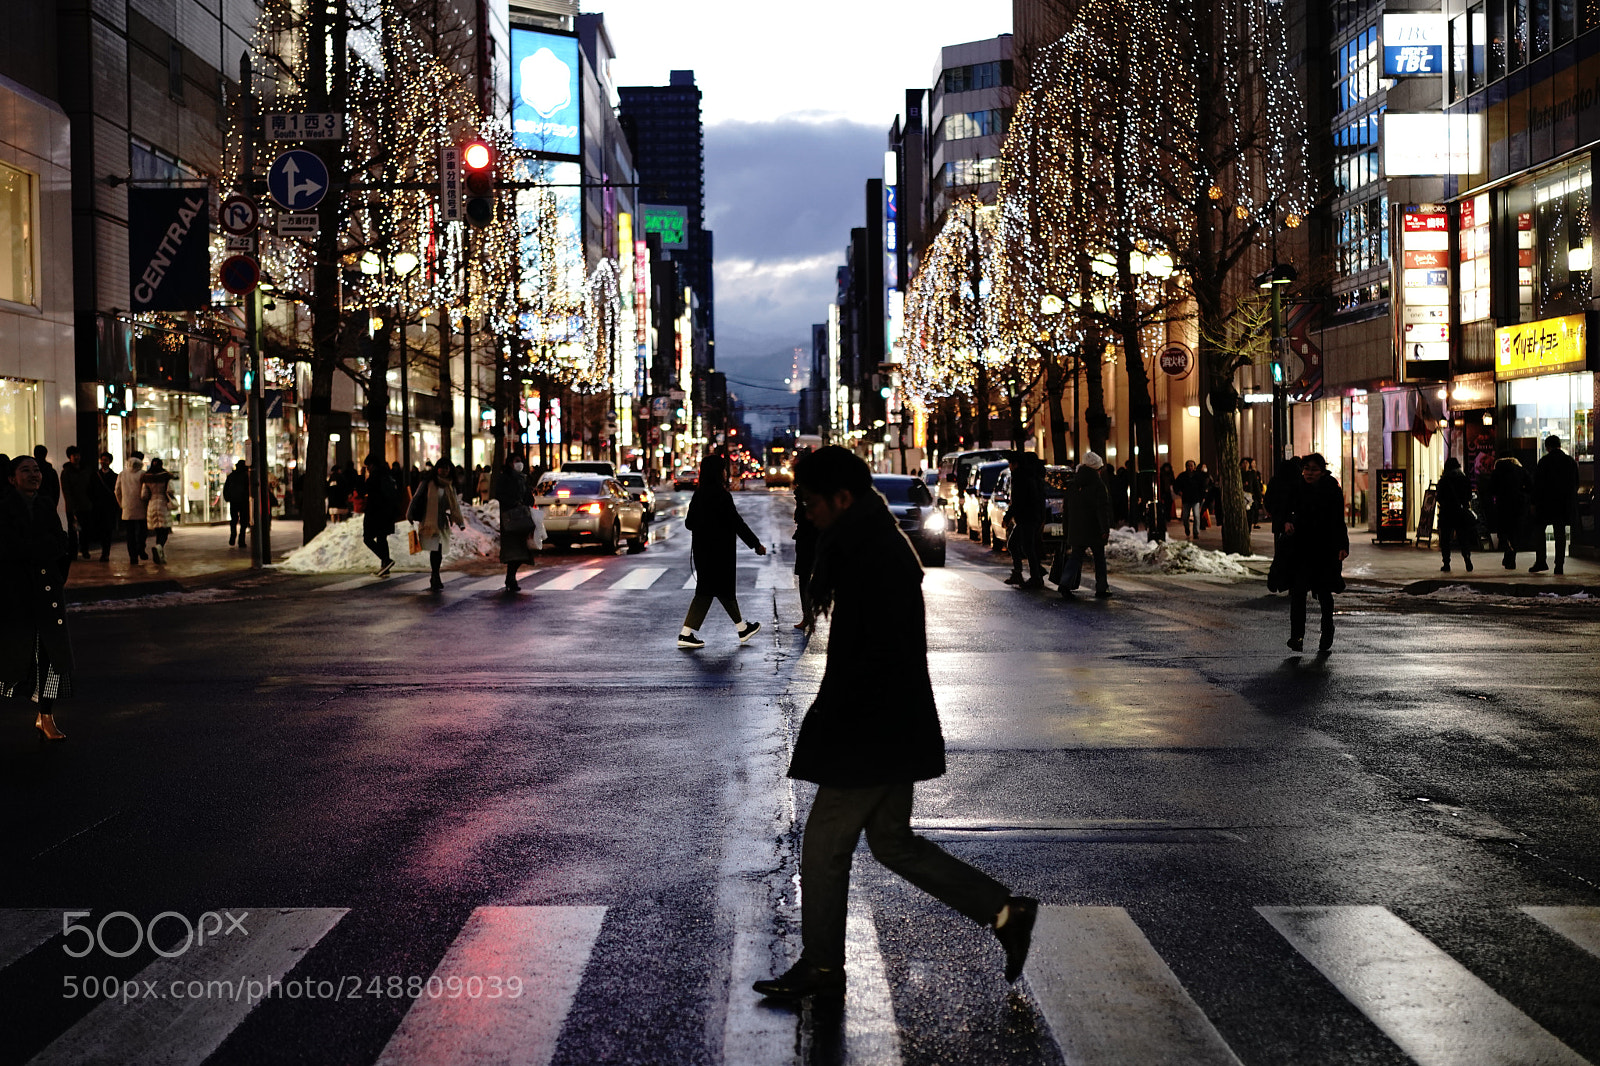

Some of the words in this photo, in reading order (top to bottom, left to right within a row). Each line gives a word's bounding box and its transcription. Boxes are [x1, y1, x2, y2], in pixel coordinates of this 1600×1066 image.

[1395, 55, 1434, 72] TBC
[271, 115, 336, 130] 南1西3
[274, 130, 297, 138] South
[306, 130, 325, 138] West
[134, 194, 205, 304] CENTRAL
[1161, 355, 1187, 368] 消火栓
[1380, 472, 1390, 527] MAJESTIC
